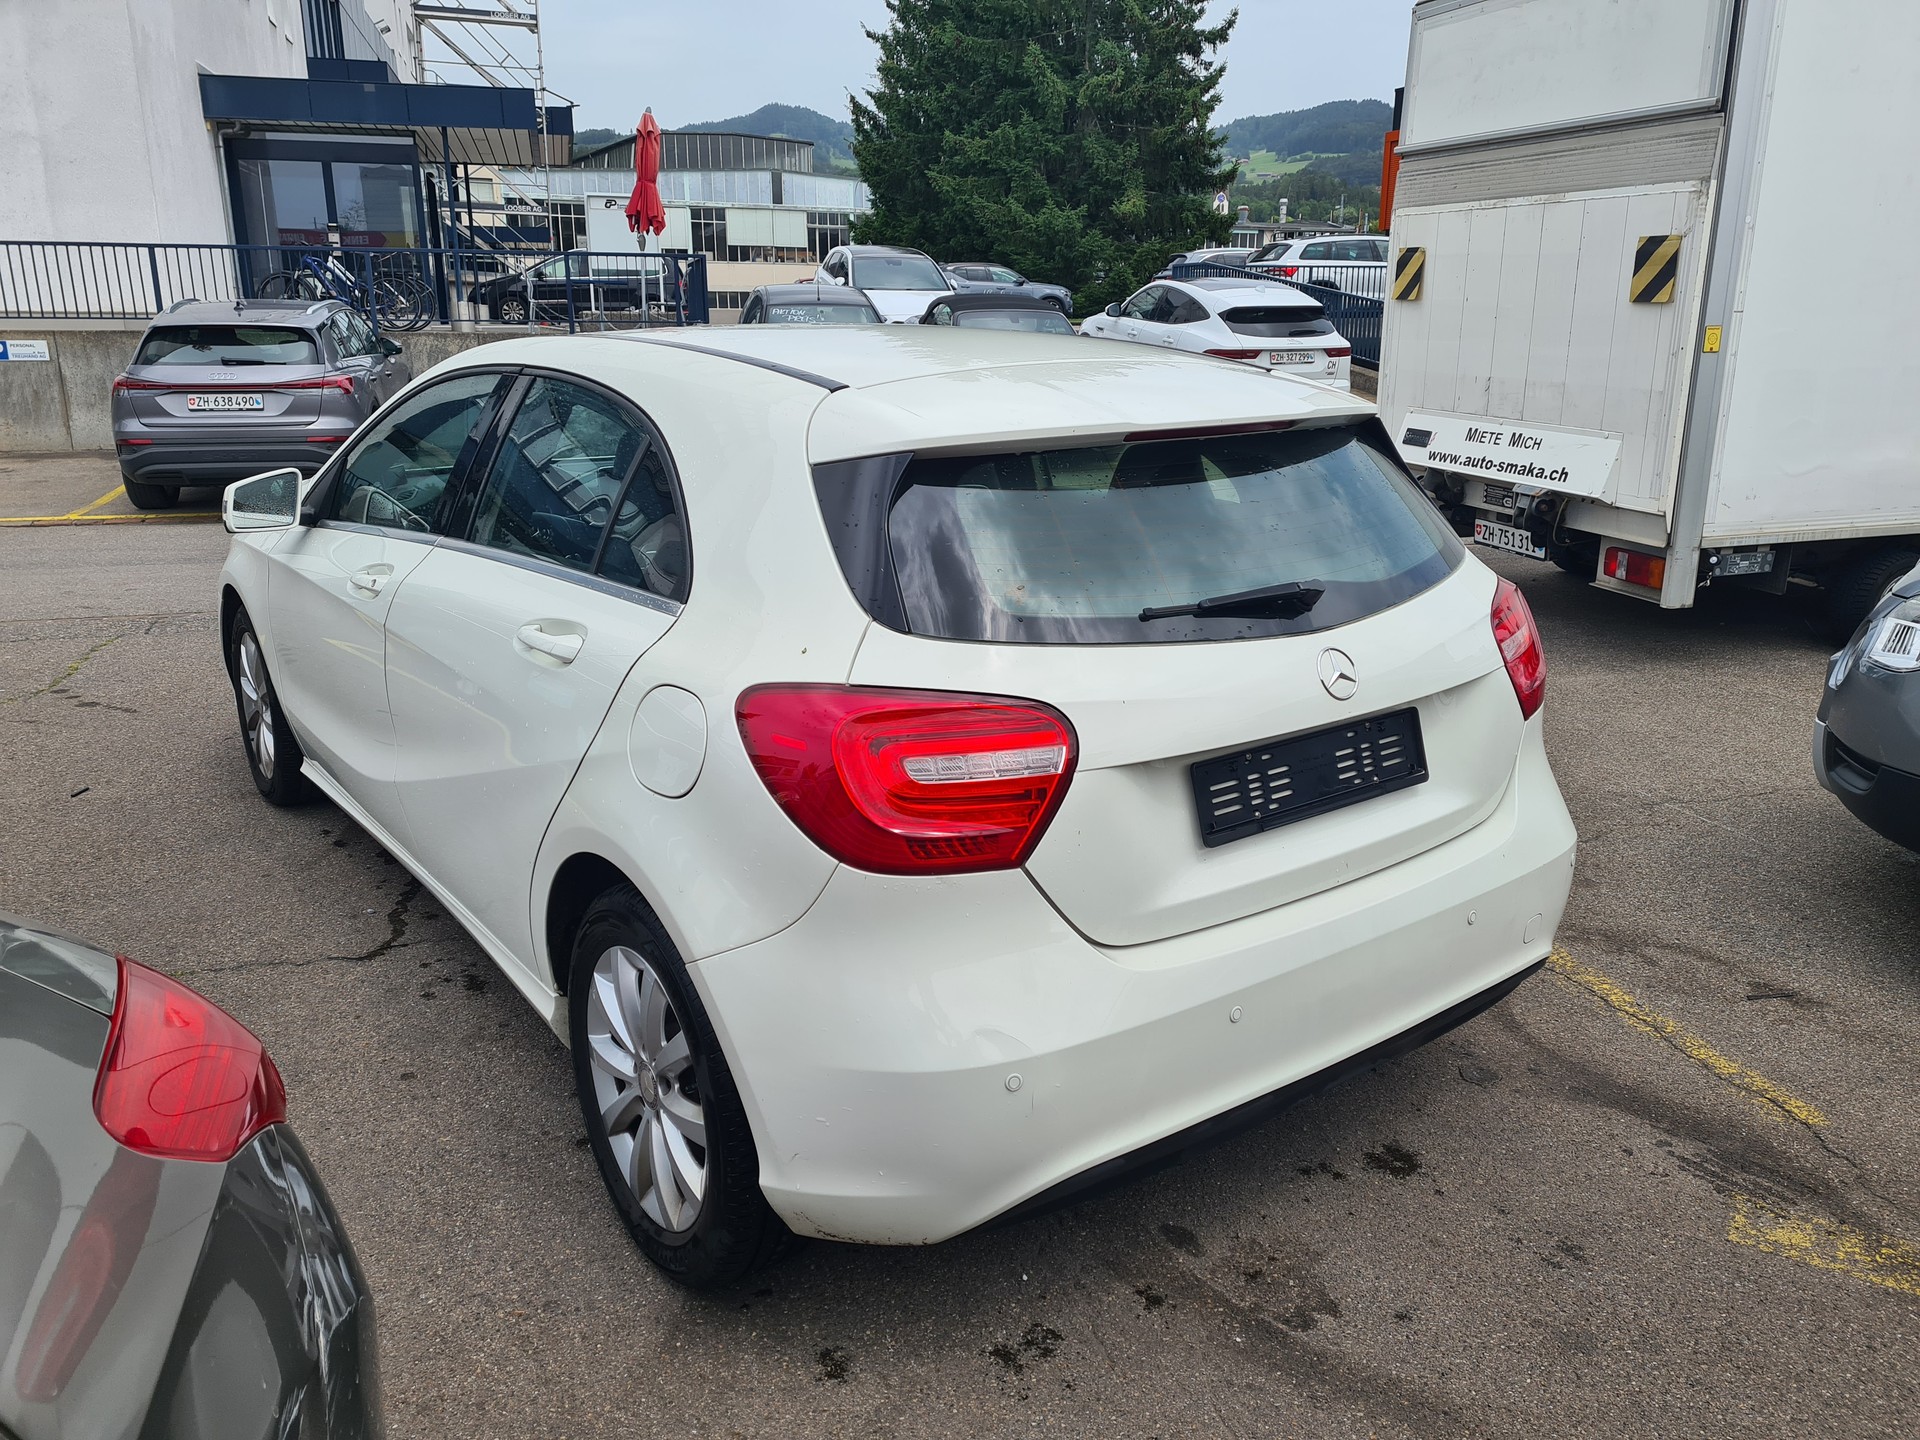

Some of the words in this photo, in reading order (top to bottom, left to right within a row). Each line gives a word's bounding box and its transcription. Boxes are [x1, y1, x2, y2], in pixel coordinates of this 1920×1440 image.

[490, 11, 519, 20] LOOSER
[504, 204, 531, 212] LOOSER
[1327, 360, 1337, 370] CH
[1428, 450, 1569, 483] www.auto-smaka.ch
